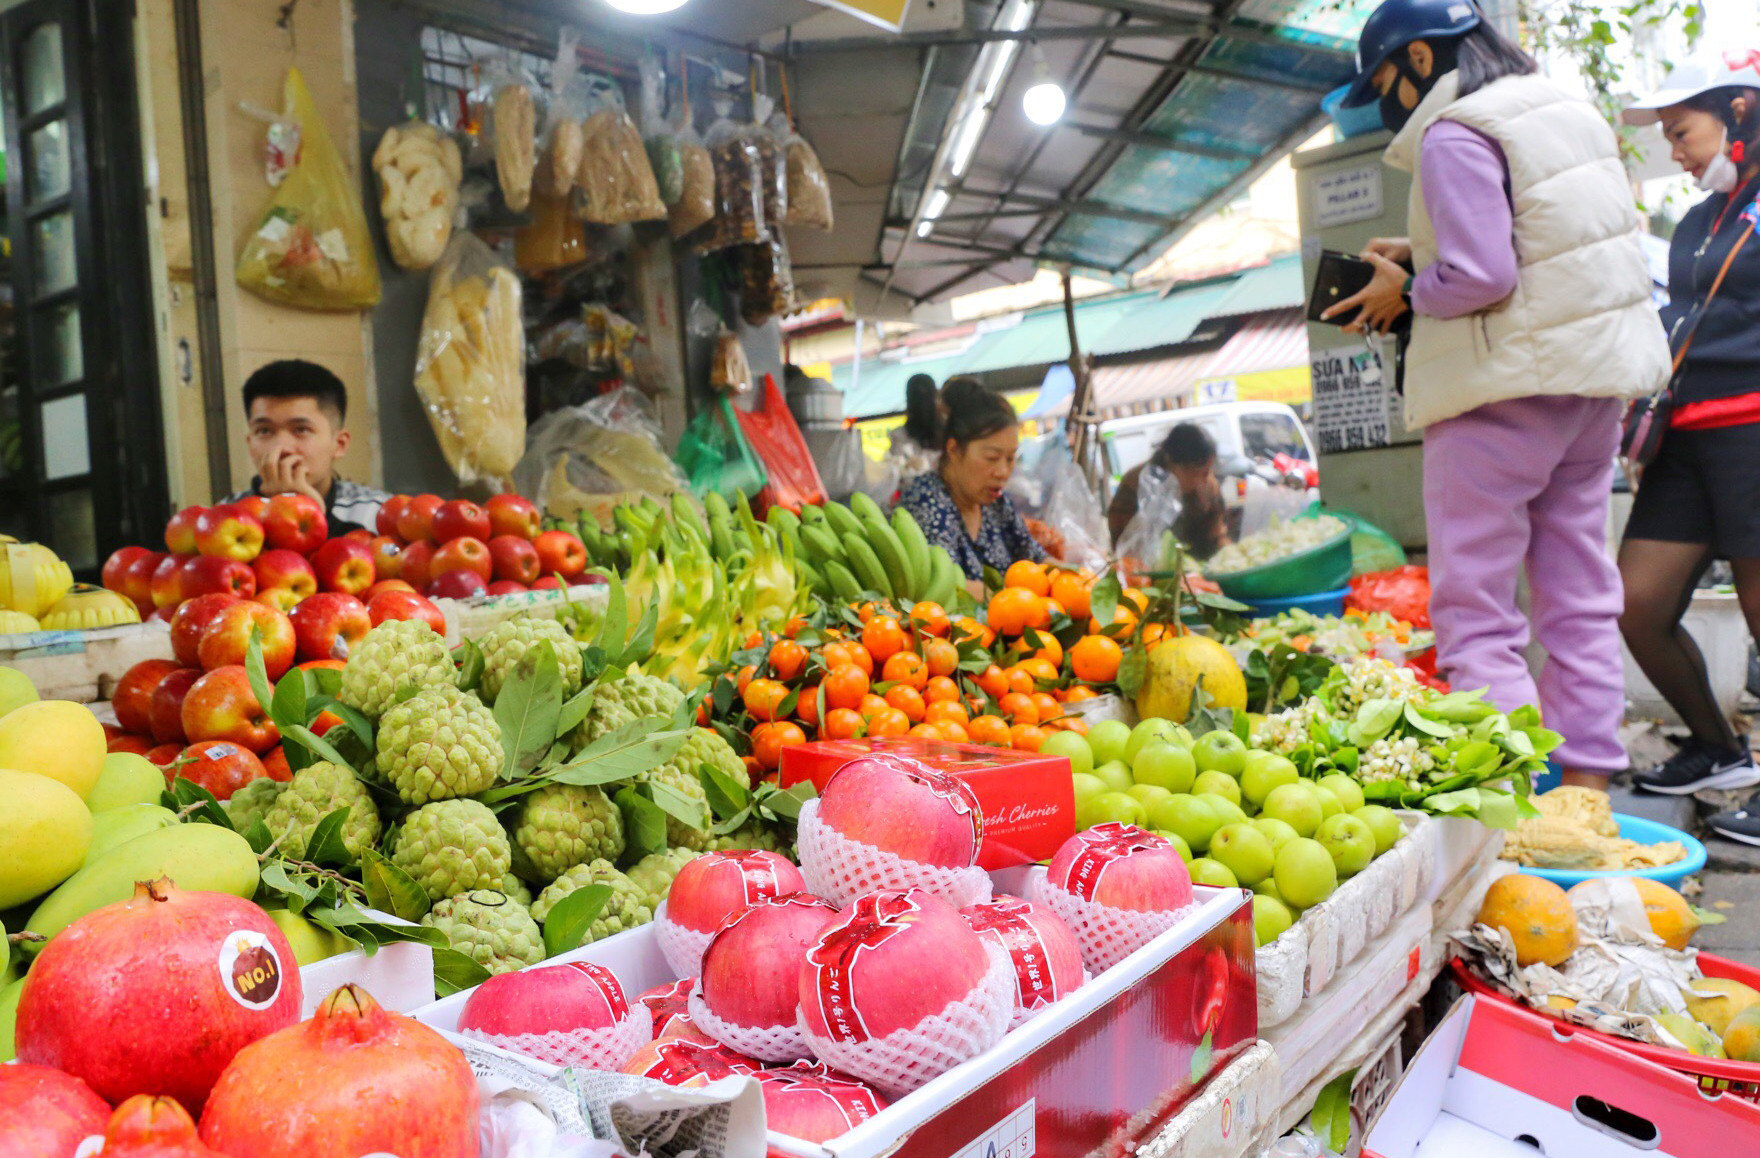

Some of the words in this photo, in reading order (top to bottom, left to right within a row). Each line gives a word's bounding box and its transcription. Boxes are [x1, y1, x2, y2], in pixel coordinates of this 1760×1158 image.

[1008, 803, 1059, 824] Cherries
[990, 826, 1016, 836] PREMIUM
[1080, 858, 1095, 879] KING
[600, 977, 621, 1003] APPLE
[850, 1099, 870, 1122] KIN
